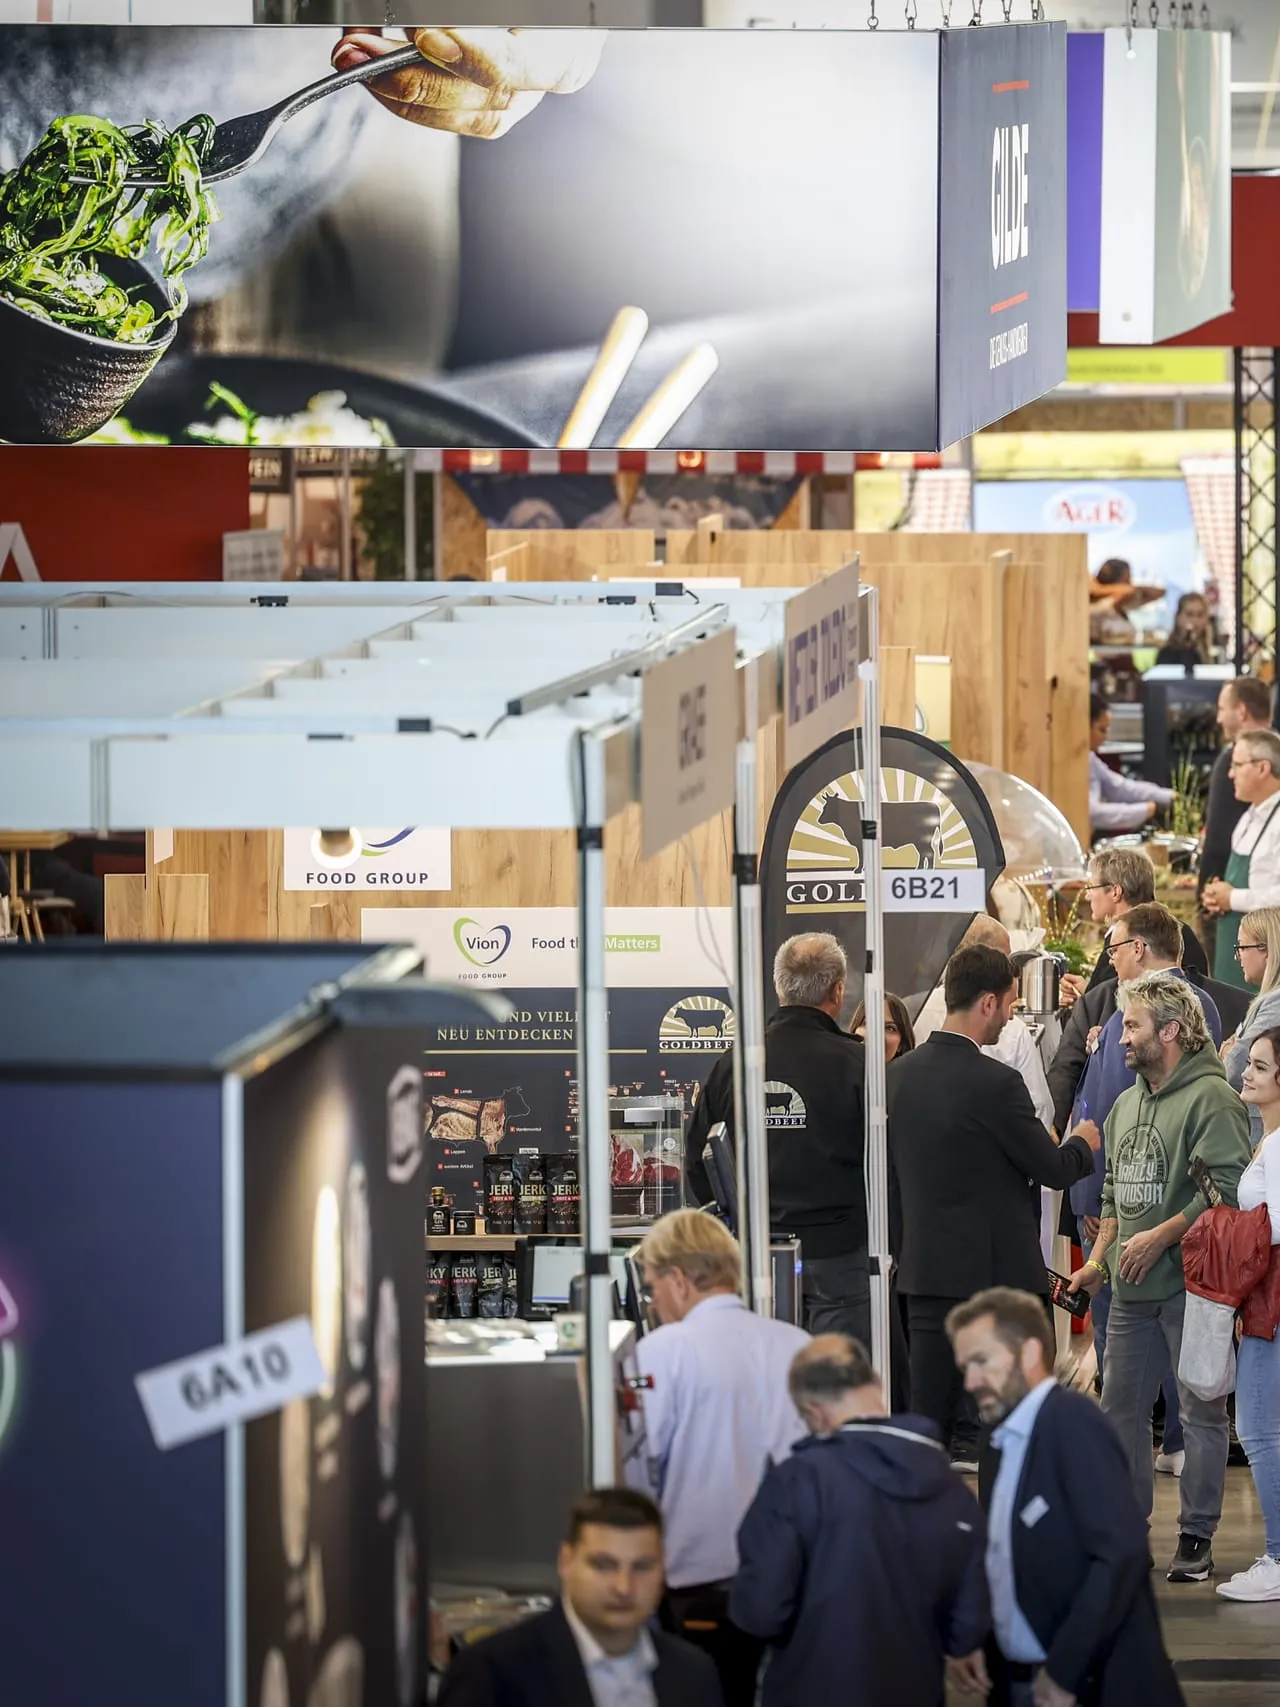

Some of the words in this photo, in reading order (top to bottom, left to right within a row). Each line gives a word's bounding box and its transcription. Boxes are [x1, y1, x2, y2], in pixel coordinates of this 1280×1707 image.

[991, 123, 1030, 270] GILDE
[306, 872, 356, 884] FOOD
[366, 872, 429, 884] GROUP
[891, 876, 959, 899] 6B21
[466, 936, 499, 950] Vion
[531, 936, 566, 950] Food
[604, 936, 658, 949] Matters
[437, 1029, 470, 1041] NEU
[476, 1029, 574, 1041] ENTDECKEN
[766, 1118, 806, 1126] DBEEF
[519, 1184, 547, 1196] JERK
[552, 1184, 579, 1196] JERK
[179, 1341, 291, 1413] 6A10
